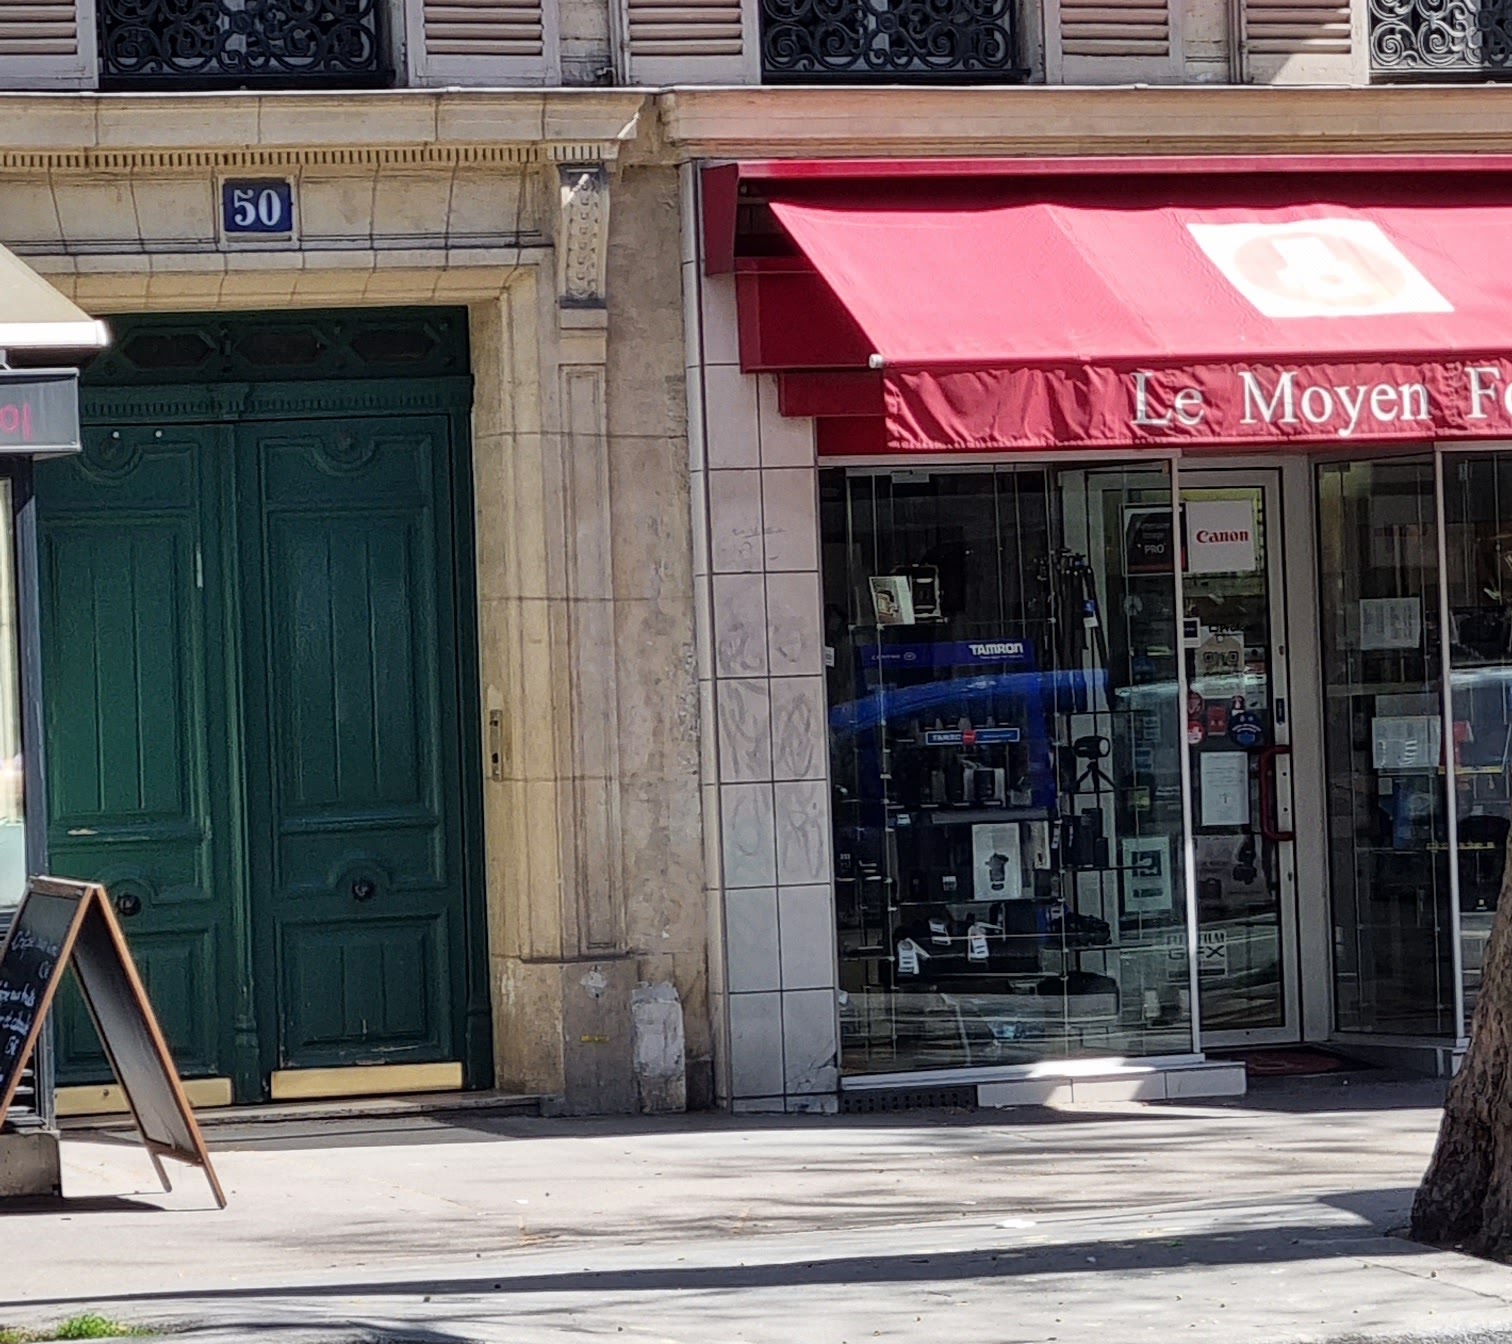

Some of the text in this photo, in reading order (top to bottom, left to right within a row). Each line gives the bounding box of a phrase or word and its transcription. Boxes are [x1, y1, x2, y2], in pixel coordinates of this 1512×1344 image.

[233, 189, 281, 226] 50
[1130, 371, 1204, 426] Le
[1239, 370, 1432, 438] Moyen
[1196, 530, 1249, 544] Canon
[968, 642, 1024, 655] TAMRON
